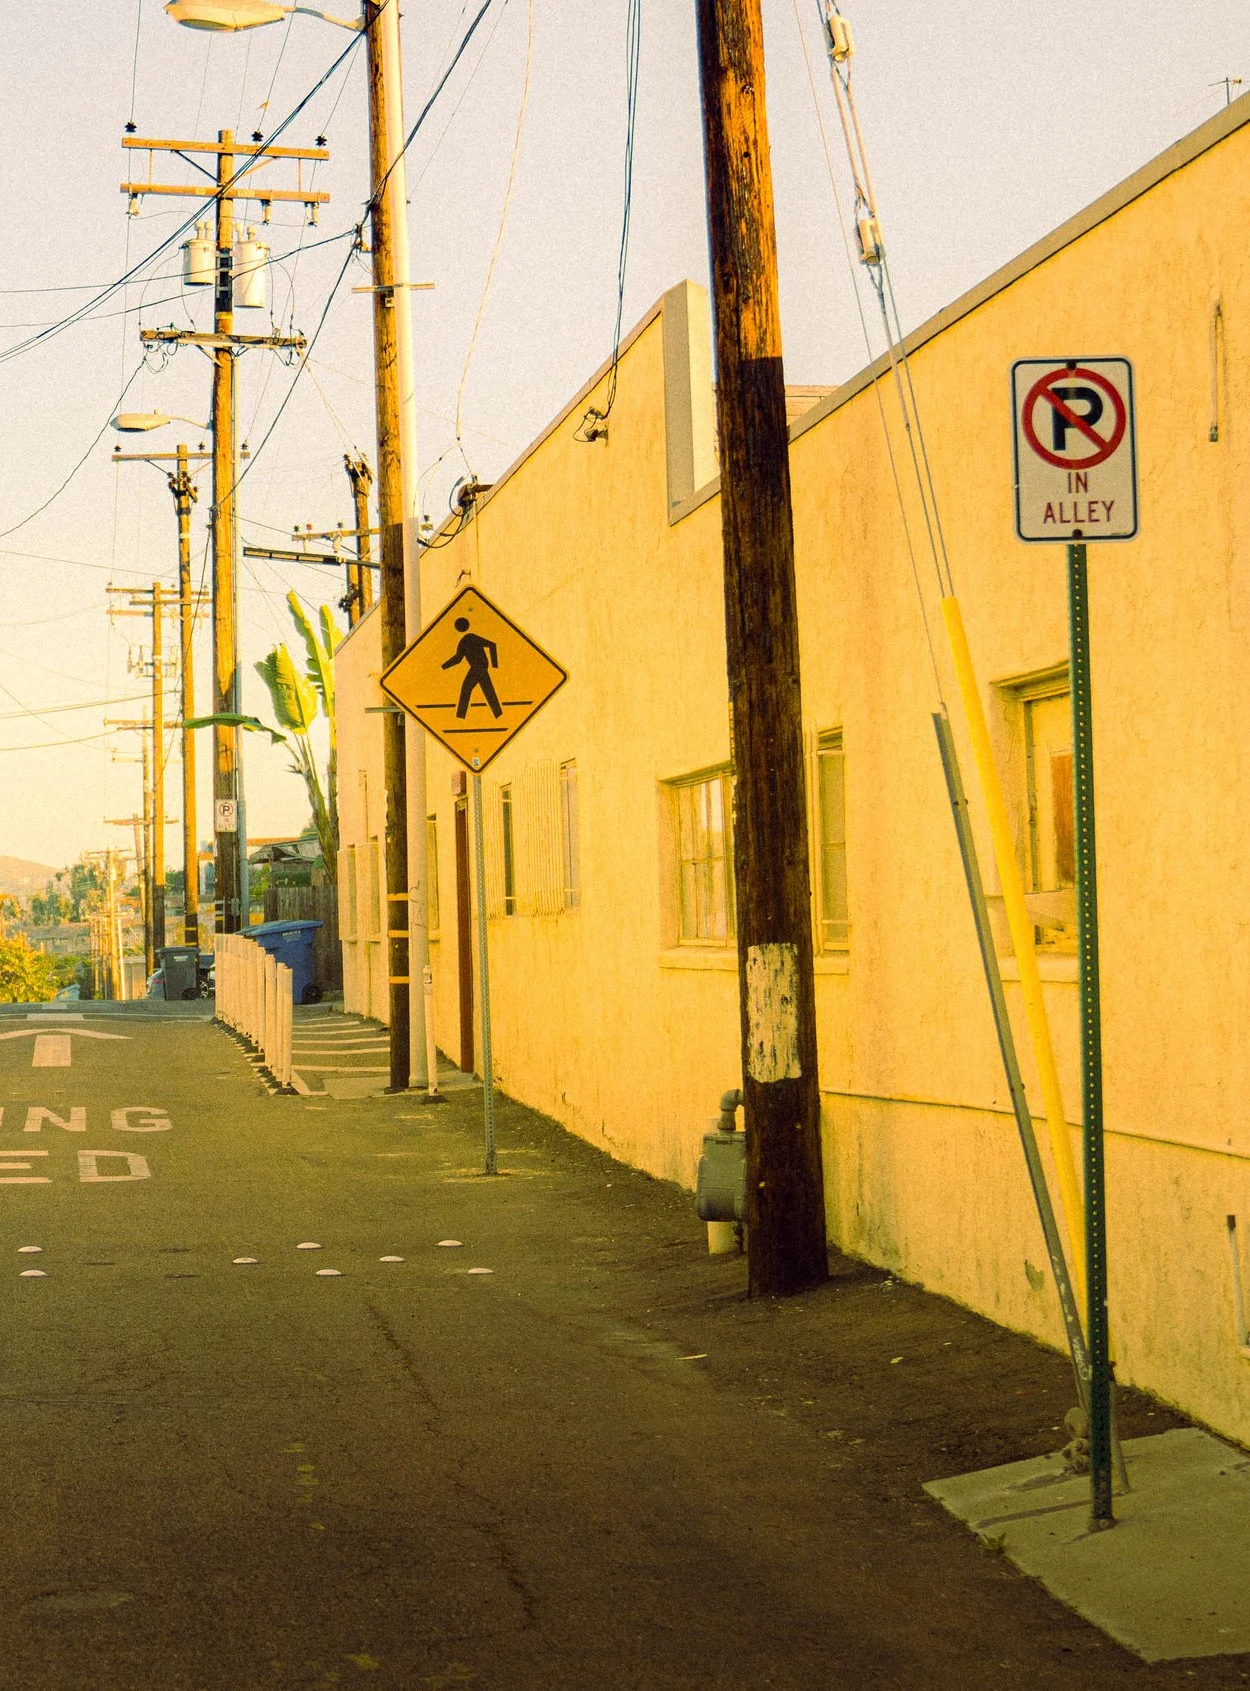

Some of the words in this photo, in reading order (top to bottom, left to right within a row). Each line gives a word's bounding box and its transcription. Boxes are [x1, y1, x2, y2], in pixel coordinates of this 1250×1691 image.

[1051, 387, 1103, 451] P
[1067, 472, 1089, 494] IN
[1043, 500, 1115, 524] ALLEY
